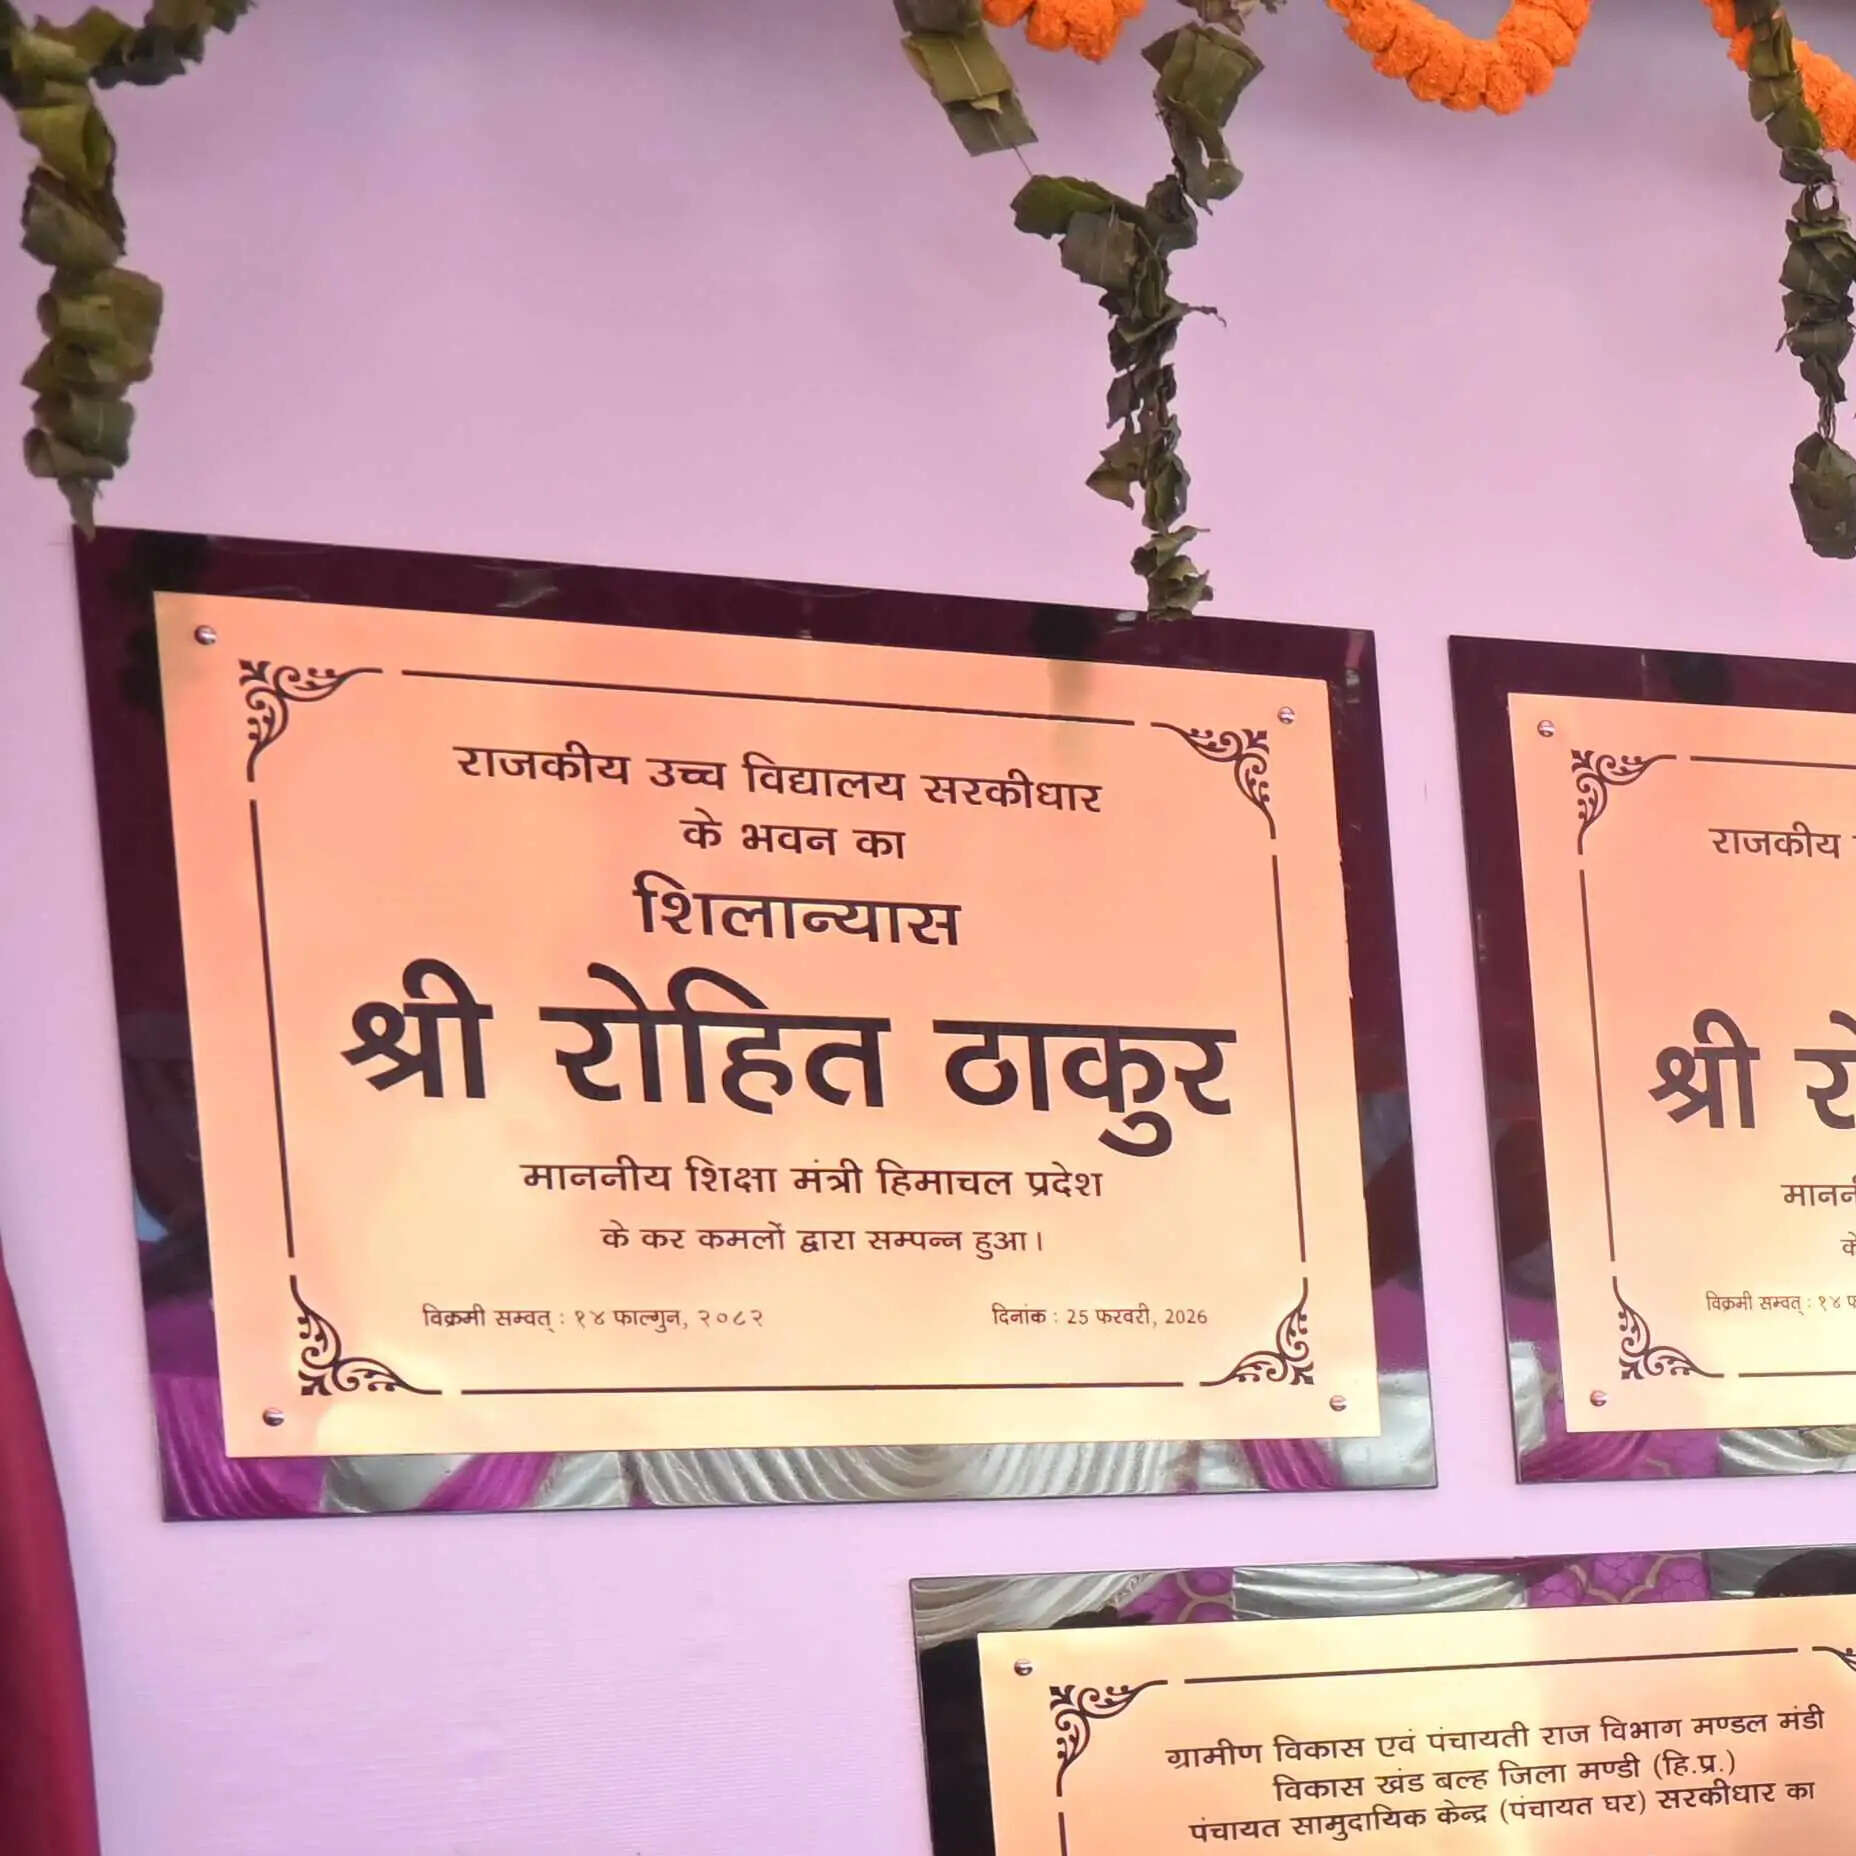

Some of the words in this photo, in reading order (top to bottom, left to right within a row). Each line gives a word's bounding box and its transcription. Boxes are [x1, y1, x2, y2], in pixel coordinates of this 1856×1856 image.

[452, 739, 632, 785] राजकीय
[645, 757, 728, 791] उच्च
[740, 750, 907, 802] विद्यालय
[919, 767, 1103, 813] सरकीधार
[678, 806, 723, 850] के
[740, 823, 839, 856] भवन
[851, 829, 907, 860] का
[1707, 820, 1842, 860] राजकीय
[631, 869, 963, 946] शिलान्यास
[340, 957, 495, 1100] श्री
[538, 961, 892, 1116] रोहित
[931, 1018, 1238, 1158] ठाकुर
[1647, 1008, 1761, 1130] श्री
[519, 1154, 673, 1192] माननीय
[684, 1154, 778, 1194] शिक्षा
[789, 1157, 864, 1194] मंत्री
[875, 1157, 1014, 1197] हिमाचल
[1024, 1160, 1104, 1198] प्रदेश
[599, 1219, 630, 1249] के
[639, 1229, 687, 1250] कर
[695, 1220, 786, 1251] कमलों
[795, 1229, 856, 1254] द्वारा
[864, 1230, 963, 1251] सम्पन्न
[422, 1302, 486, 1328] विक्रमी
[574, 1309, 606, 1329] १४
[611, 1309, 688, 1334] फाल्गुन,
[697, 1309, 763, 1328] २०८२
[1067, 1308, 1089, 1326] 25
[1094, 1302, 1158, 1327] फरवरी,
[1164, 1308, 1208, 1325] 2026
[1705, 1290, 1753, 1312] विक्रमी
[1817, 1295, 1841, 1312] १४
[1164, 1737, 1263, 1770] ग्रामीण
[1272, 1734, 1366, 1763] विकास
[1374, 1735, 1417, 1758] एवं
[1425, 1720, 1530, 1753] पंचायती
[1538, 1724, 1591, 1746] राज
[1599, 1714, 1683, 1742] विभाग
[1690, 1713, 1769, 1736] मण्डल
[1776, 1703, 1825, 1731] मंडी
[1272, 1773, 1366, 1802] विकास
[1373, 1767, 1425, 1795] खंड
[1431, 1769, 1489, 1791] बल्ह
[1497, 1759, 1568, 1787] जिला
[1575, 1751, 1641, 1781] मण्डी
[1653, 1748, 1736, 1781] (हि.प्र.)
[1187, 1816, 1281, 1843] पंचायत
[1288, 1802, 1427, 1842] सामुदायिक
[1434, 1798, 1489, 1825] केन्द्र
[1500, 1795, 1594, 1825] (पंचायत
[1601, 1789, 1646, 1816] घर)
[1655, 1777, 1777, 1810] सरकीधार
[1784, 1781, 1816, 1801] का
